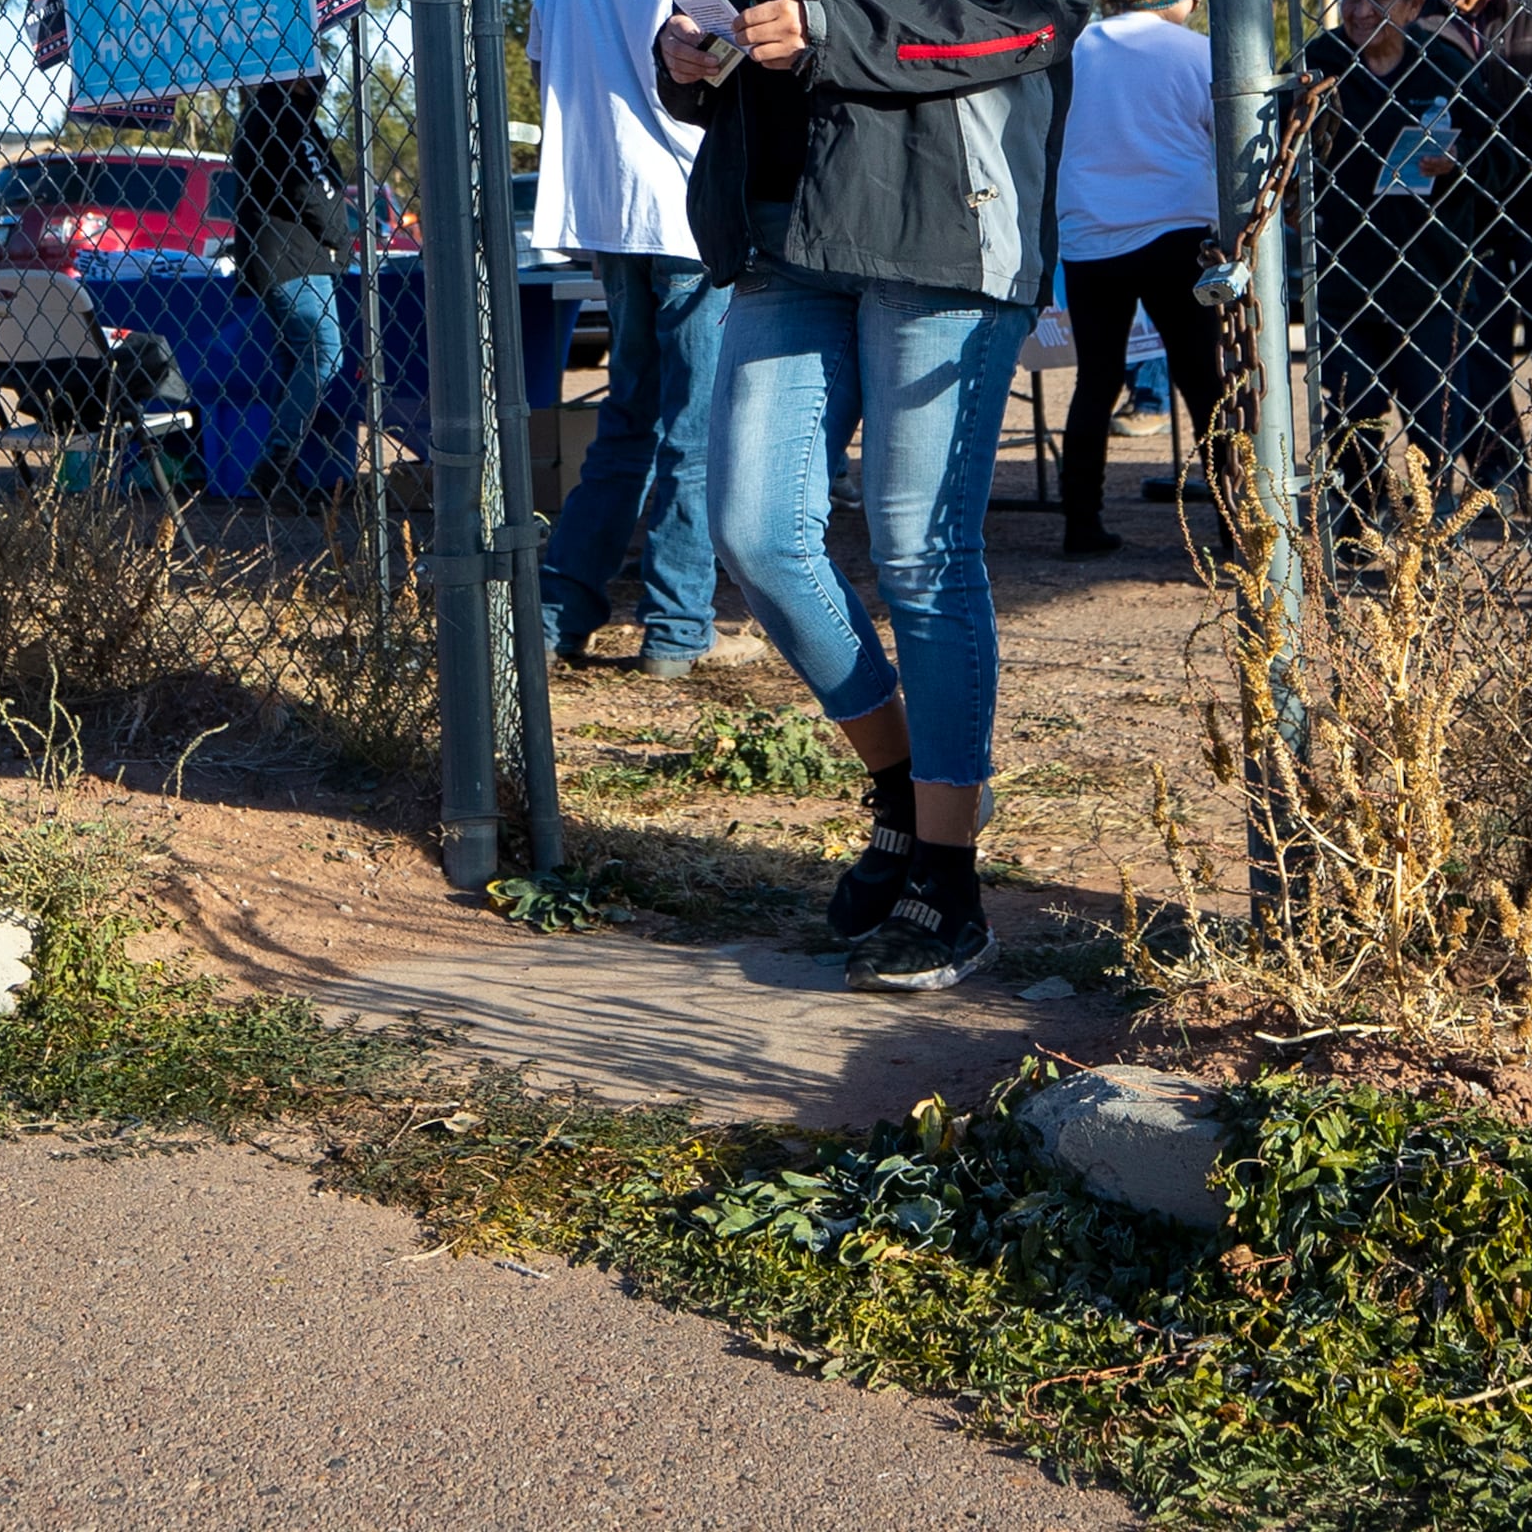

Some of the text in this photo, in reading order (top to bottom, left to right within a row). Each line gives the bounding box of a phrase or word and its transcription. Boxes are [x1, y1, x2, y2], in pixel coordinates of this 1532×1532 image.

[98, 4, 279, 64] HIGH TAXES
[171, 61, 208, 79] 02
[873, 825, 911, 856] MA
[890, 898, 943, 933] UMA
